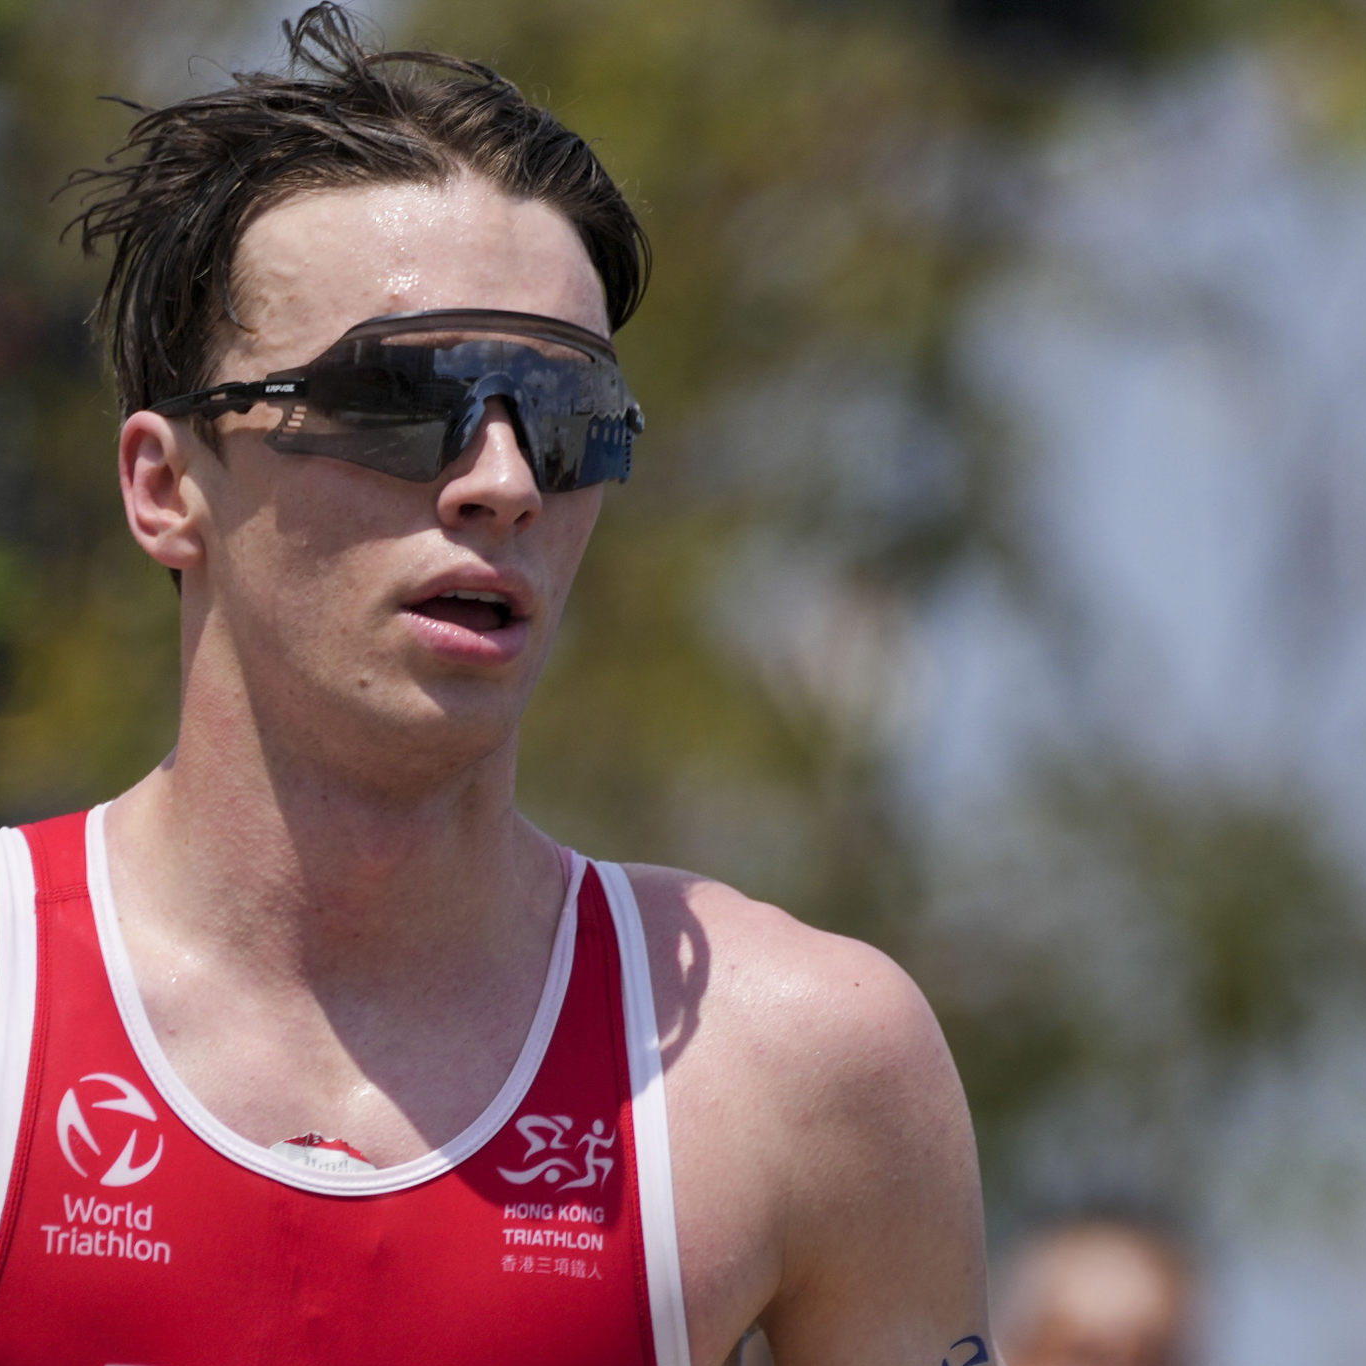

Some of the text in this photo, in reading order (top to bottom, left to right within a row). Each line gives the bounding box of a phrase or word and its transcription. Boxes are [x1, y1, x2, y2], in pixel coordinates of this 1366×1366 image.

[63, 1193, 153, 1231] World
[503, 1203, 605, 1224] HONG KONG
[40, 1225, 171, 1264] Triathlon
[502, 1228, 604, 1251] TRIATHLON
